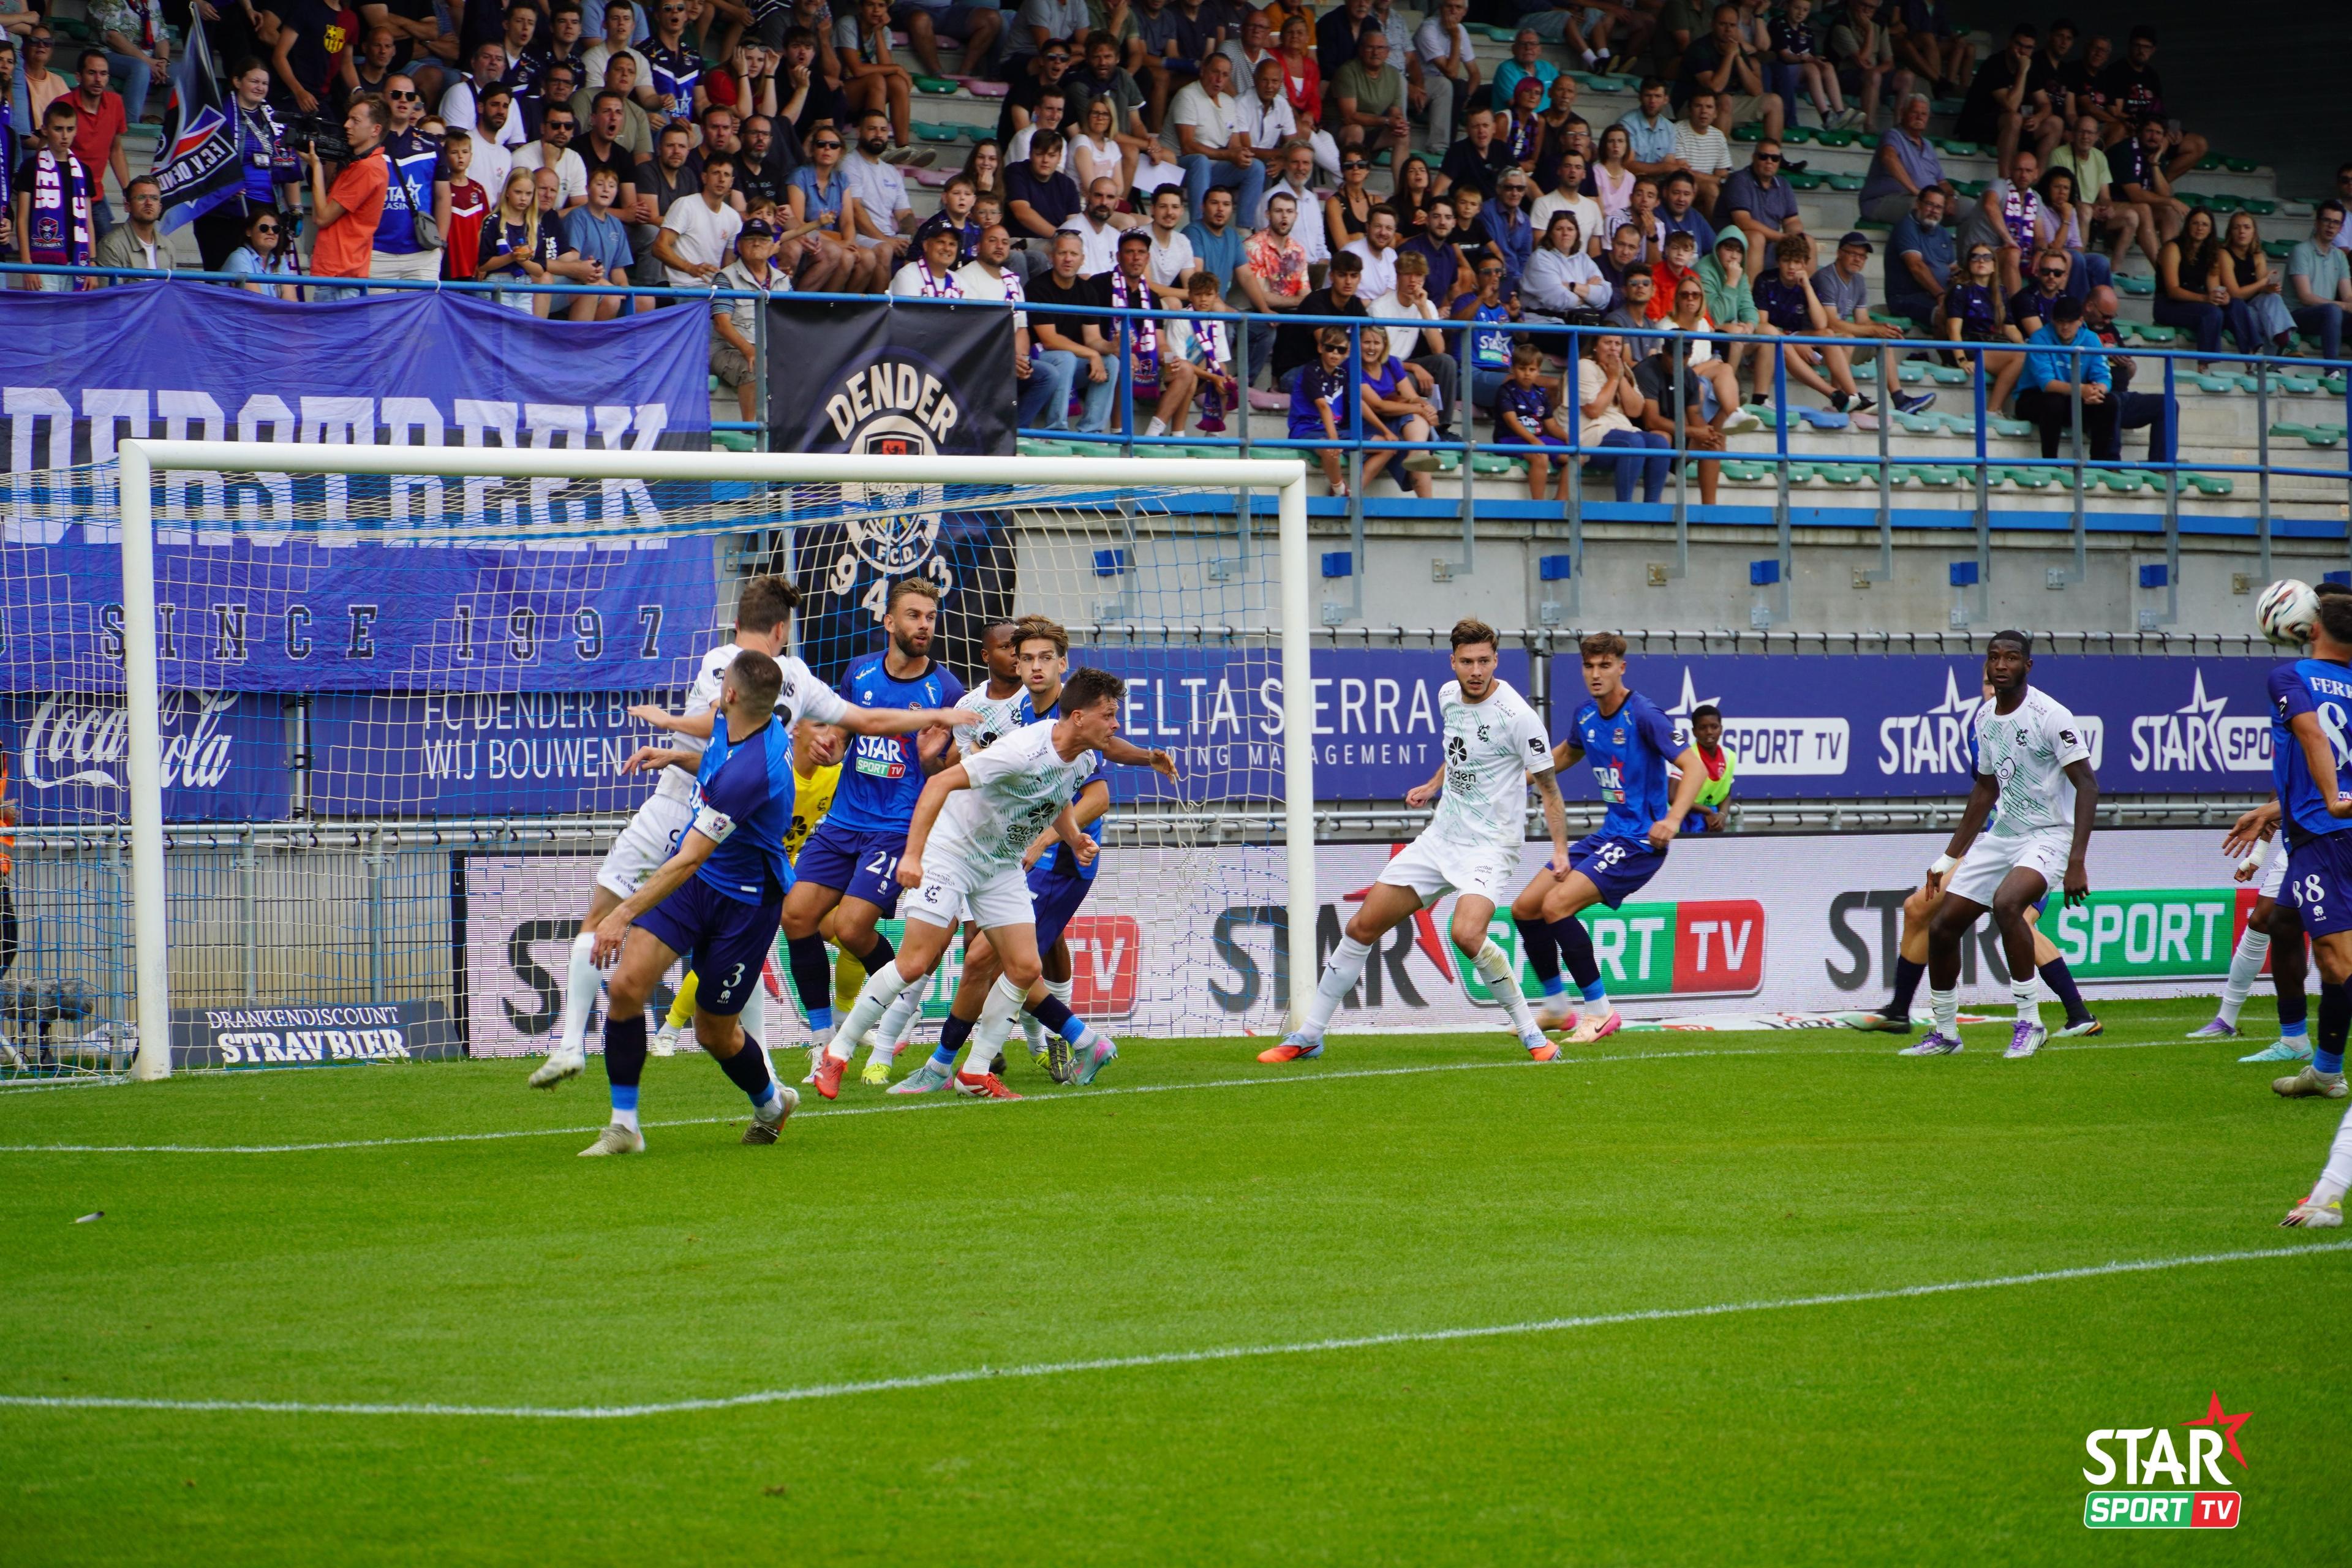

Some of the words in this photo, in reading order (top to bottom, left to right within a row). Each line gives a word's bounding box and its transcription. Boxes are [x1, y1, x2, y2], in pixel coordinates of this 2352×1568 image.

[825, 362, 959, 445] DENDER
[99, 603, 379, 660] SINCE
[454, 604, 663, 662] 1997
[424, 690, 462, 731] FC
[474, 690, 597, 730] DENDER
[1125, 677, 1241, 736] ELTA
[1259, 677, 1437, 736] SERRA
[424, 739, 478, 780] WIJ
[488, 737, 623, 780] BOUWEN
[856, 736, 903, 763] STAR
[1249, 744, 1428, 765] MAAGEMENT
[1722, 729, 1803, 764] SPORT
[1815, 732, 1842, 760] TV
[1877, 714, 1966, 775] STAR
[2130, 714, 2216, 772] STAR
[857, 759, 888, 775] SPORT
[891, 766, 903, 775] TV
[865, 850, 898, 880] 21
[1594, 842, 1626, 865] 18
[2292, 873, 2325, 908] 88
[1487, 918, 1667, 984] SRT
[1689, 920, 1753, 973] TV
[1825, 886, 2011, 990] STR
[2058, 902, 2226, 965] SPORT
[722, 962, 745, 988] 3
[205, 1006, 399, 1030] DRANKENDISCOUNT
